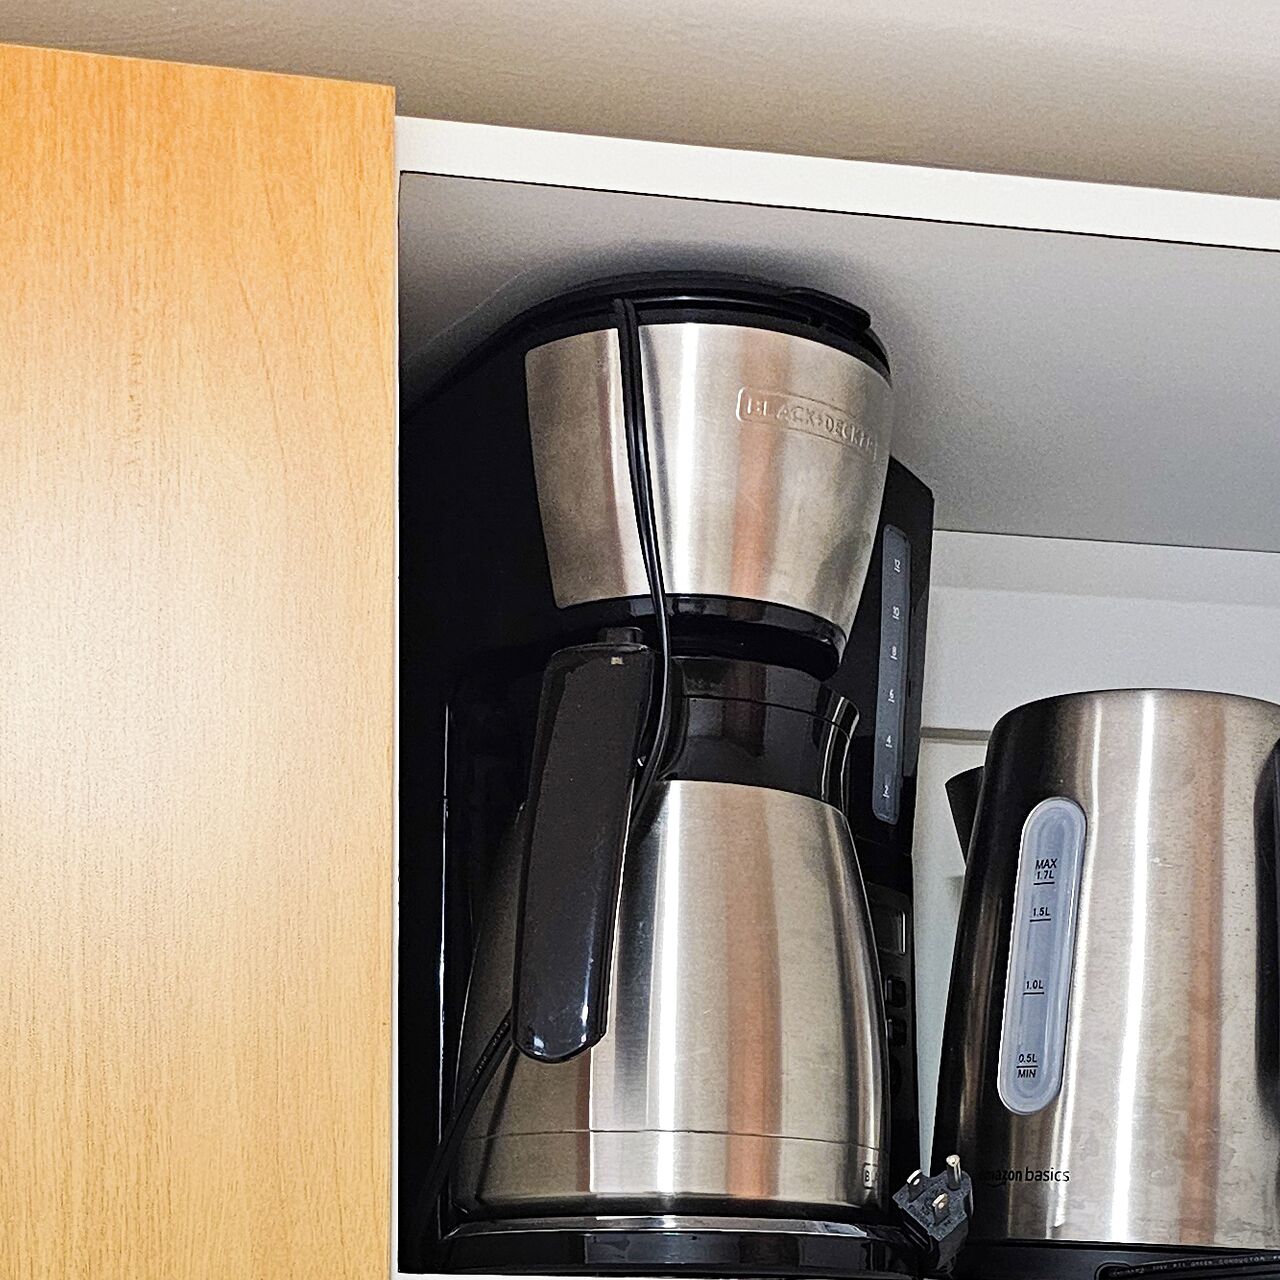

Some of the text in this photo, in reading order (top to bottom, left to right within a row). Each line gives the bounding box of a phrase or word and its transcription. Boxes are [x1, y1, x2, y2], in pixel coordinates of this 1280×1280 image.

[886, 735, 892, 744] 4
[884, 785, 889, 795] 2
[1035, 859, 1057, 870] MAX
[1036, 870, 1054, 880] 1.7L
[1032, 907, 1050, 917] 1.5L
[1025, 980, 1043, 990] 1.0L
[1018, 1053, 1038, 1064] 0.5L
[1017, 1068, 1036, 1078] MIN
[1025, 1167, 1070, 1182] basics
[1219, 1257, 1265, 1265] CONDUCTOR
